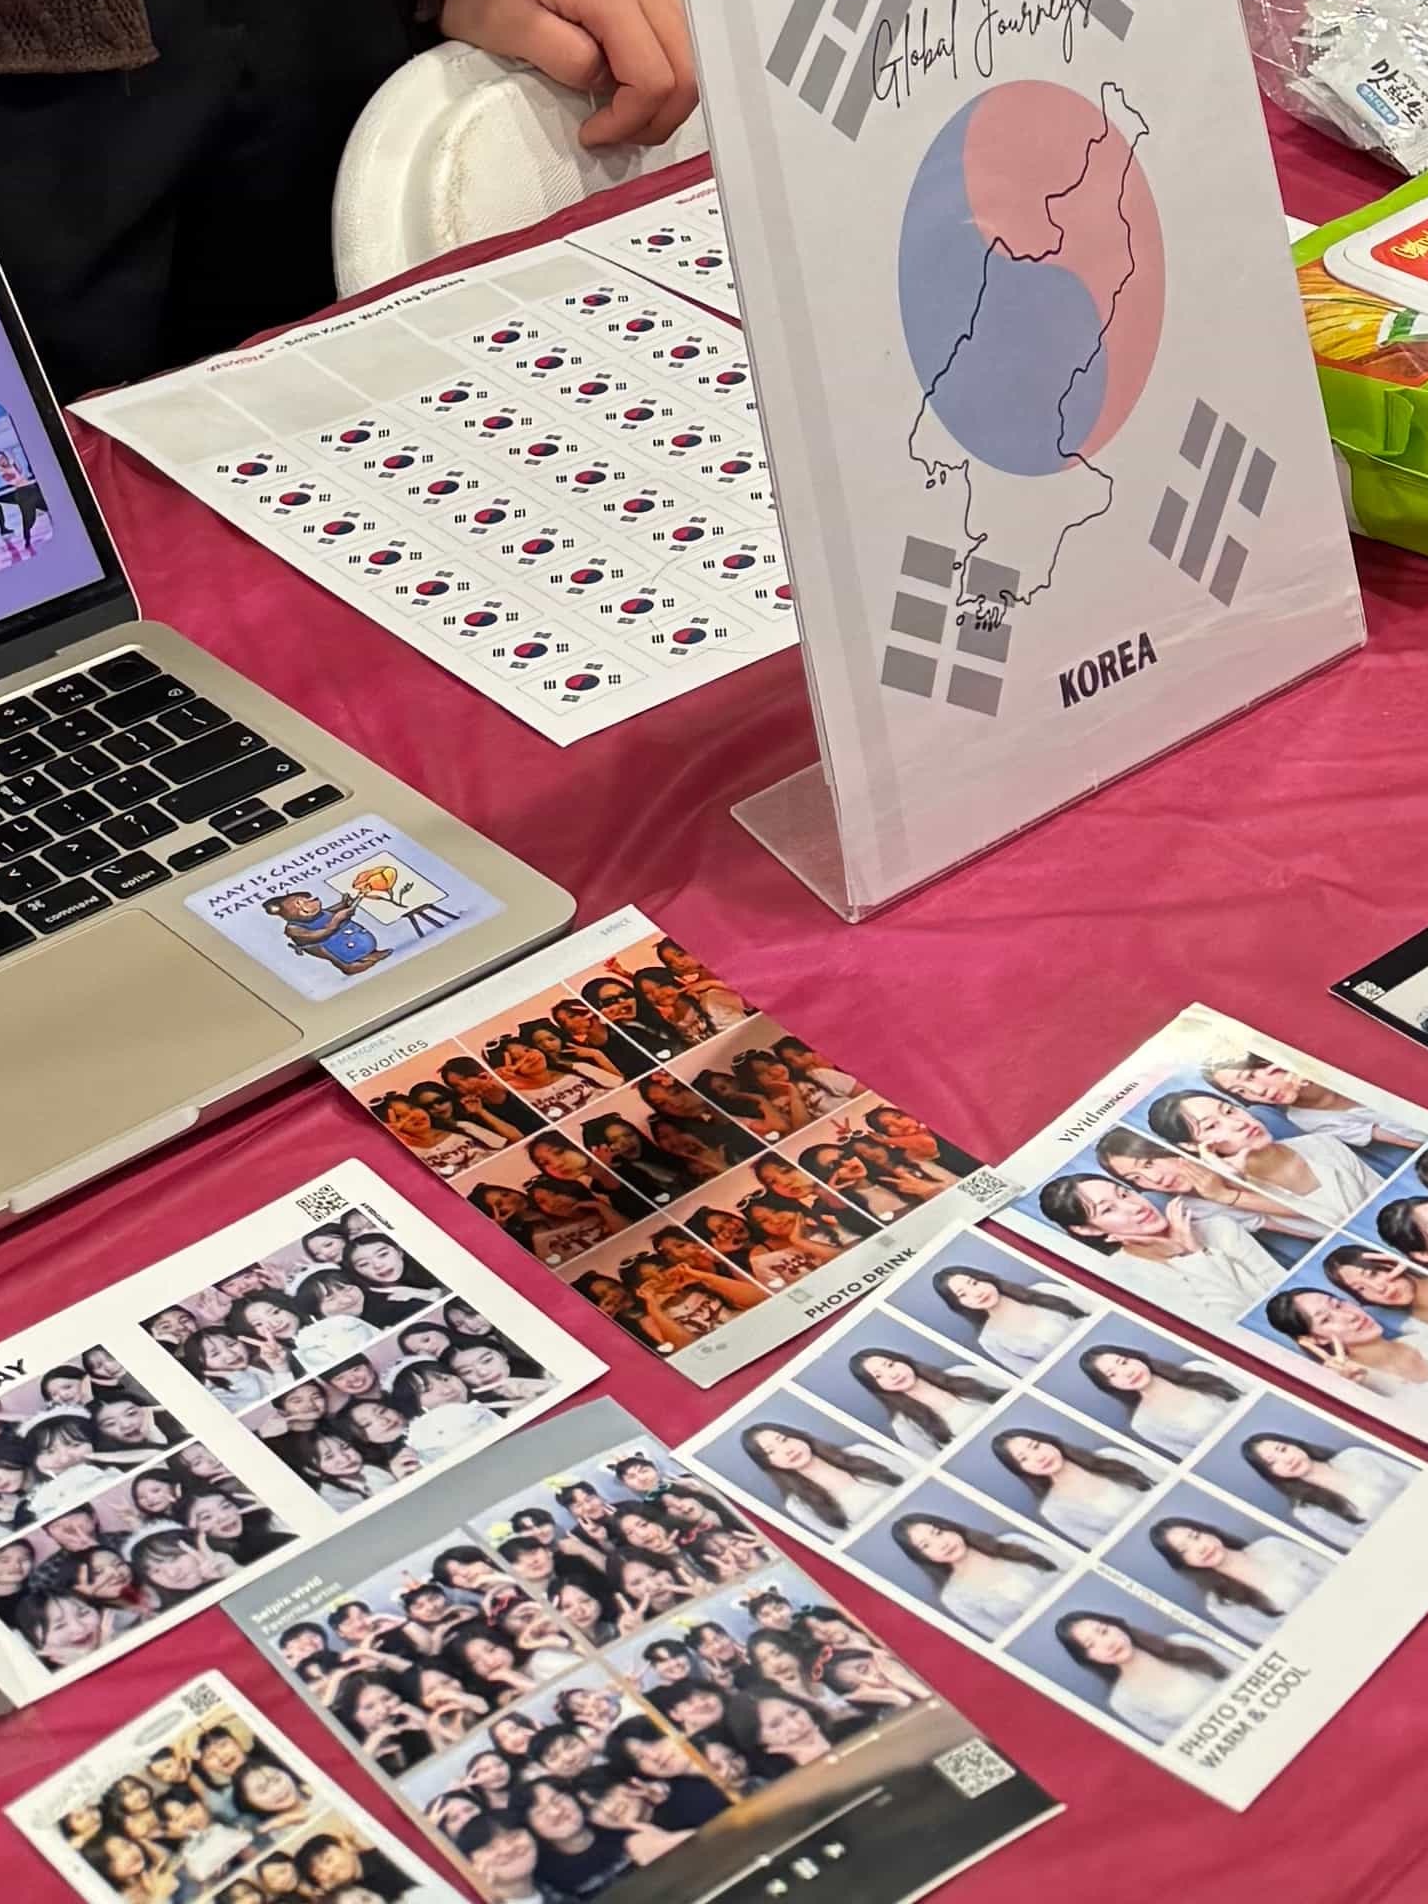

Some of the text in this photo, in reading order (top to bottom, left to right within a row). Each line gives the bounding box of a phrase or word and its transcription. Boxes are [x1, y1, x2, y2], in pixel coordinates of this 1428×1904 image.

[1058, 631, 1159, 709] KOREA
[208, 826, 375, 908] MAY IS CALIFORNIA
[213, 831, 392, 920] STATE PARKS MONTH
[345, 1038, 430, 1084] Favorites
[803, 1246, 918, 1320] PHOTO DRINK
[1177, 1649, 1289, 1758] PHOTO STREET
[1198, 1665, 1313, 1770] WARM & COOL
